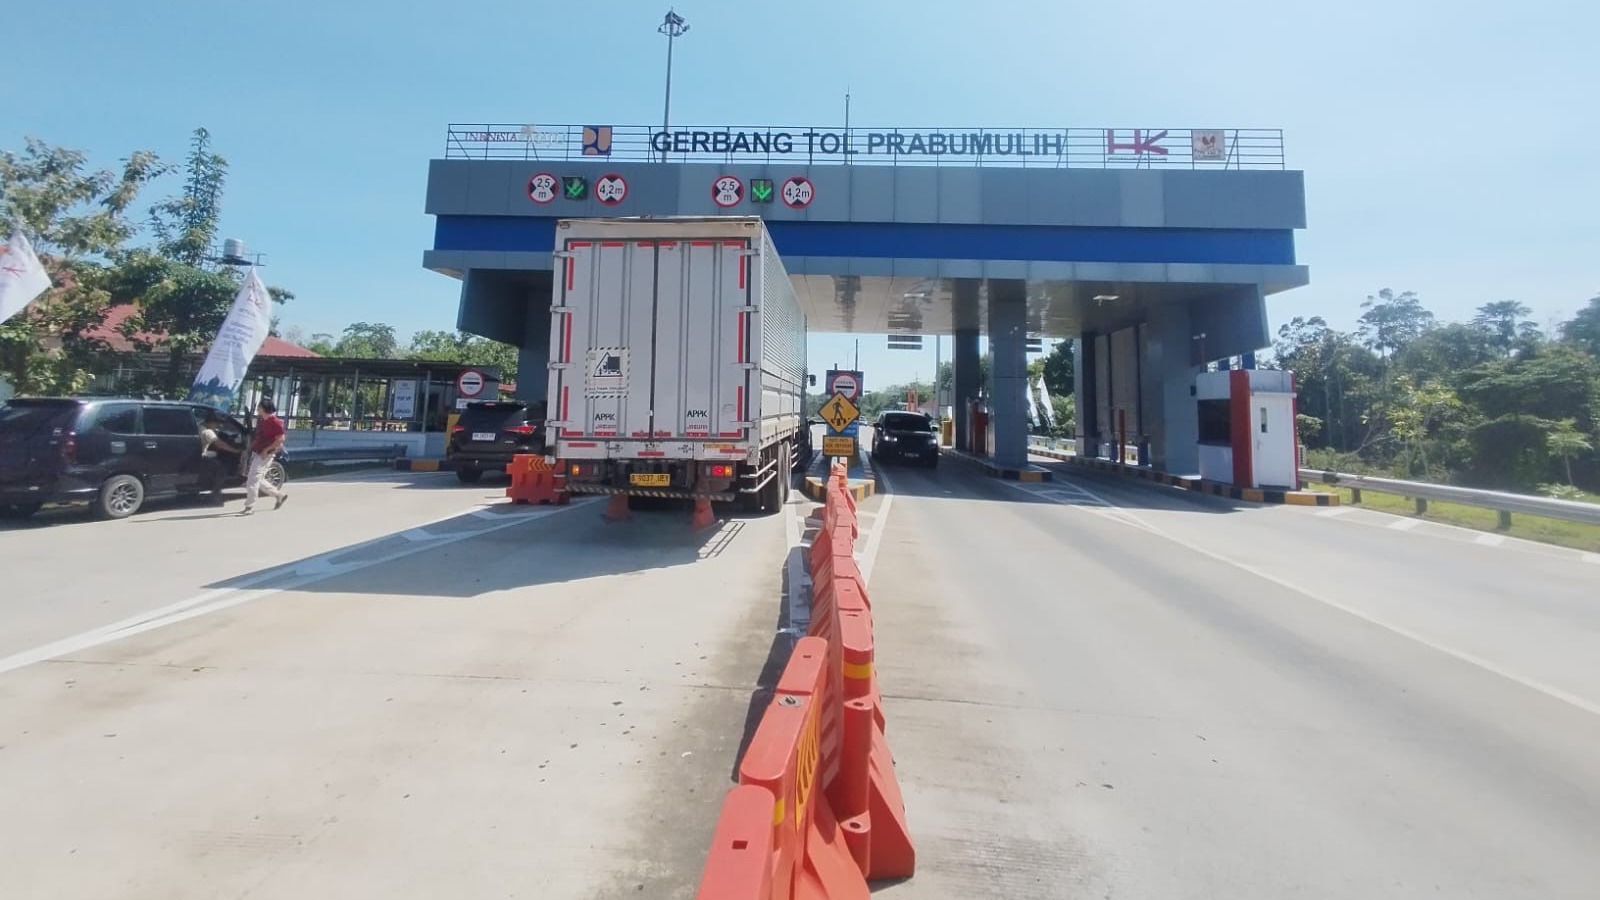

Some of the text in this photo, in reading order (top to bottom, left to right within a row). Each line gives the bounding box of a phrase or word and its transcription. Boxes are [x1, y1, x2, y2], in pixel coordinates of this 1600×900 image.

[653, 131, 1061, 155] GERBANG TOL PRABUMULIH
[537, 178, 550, 189] 2,5
[721, 181, 735, 192] 2,5
[594, 413, 615, 421] APPK
[687, 410, 708, 418] APPK
